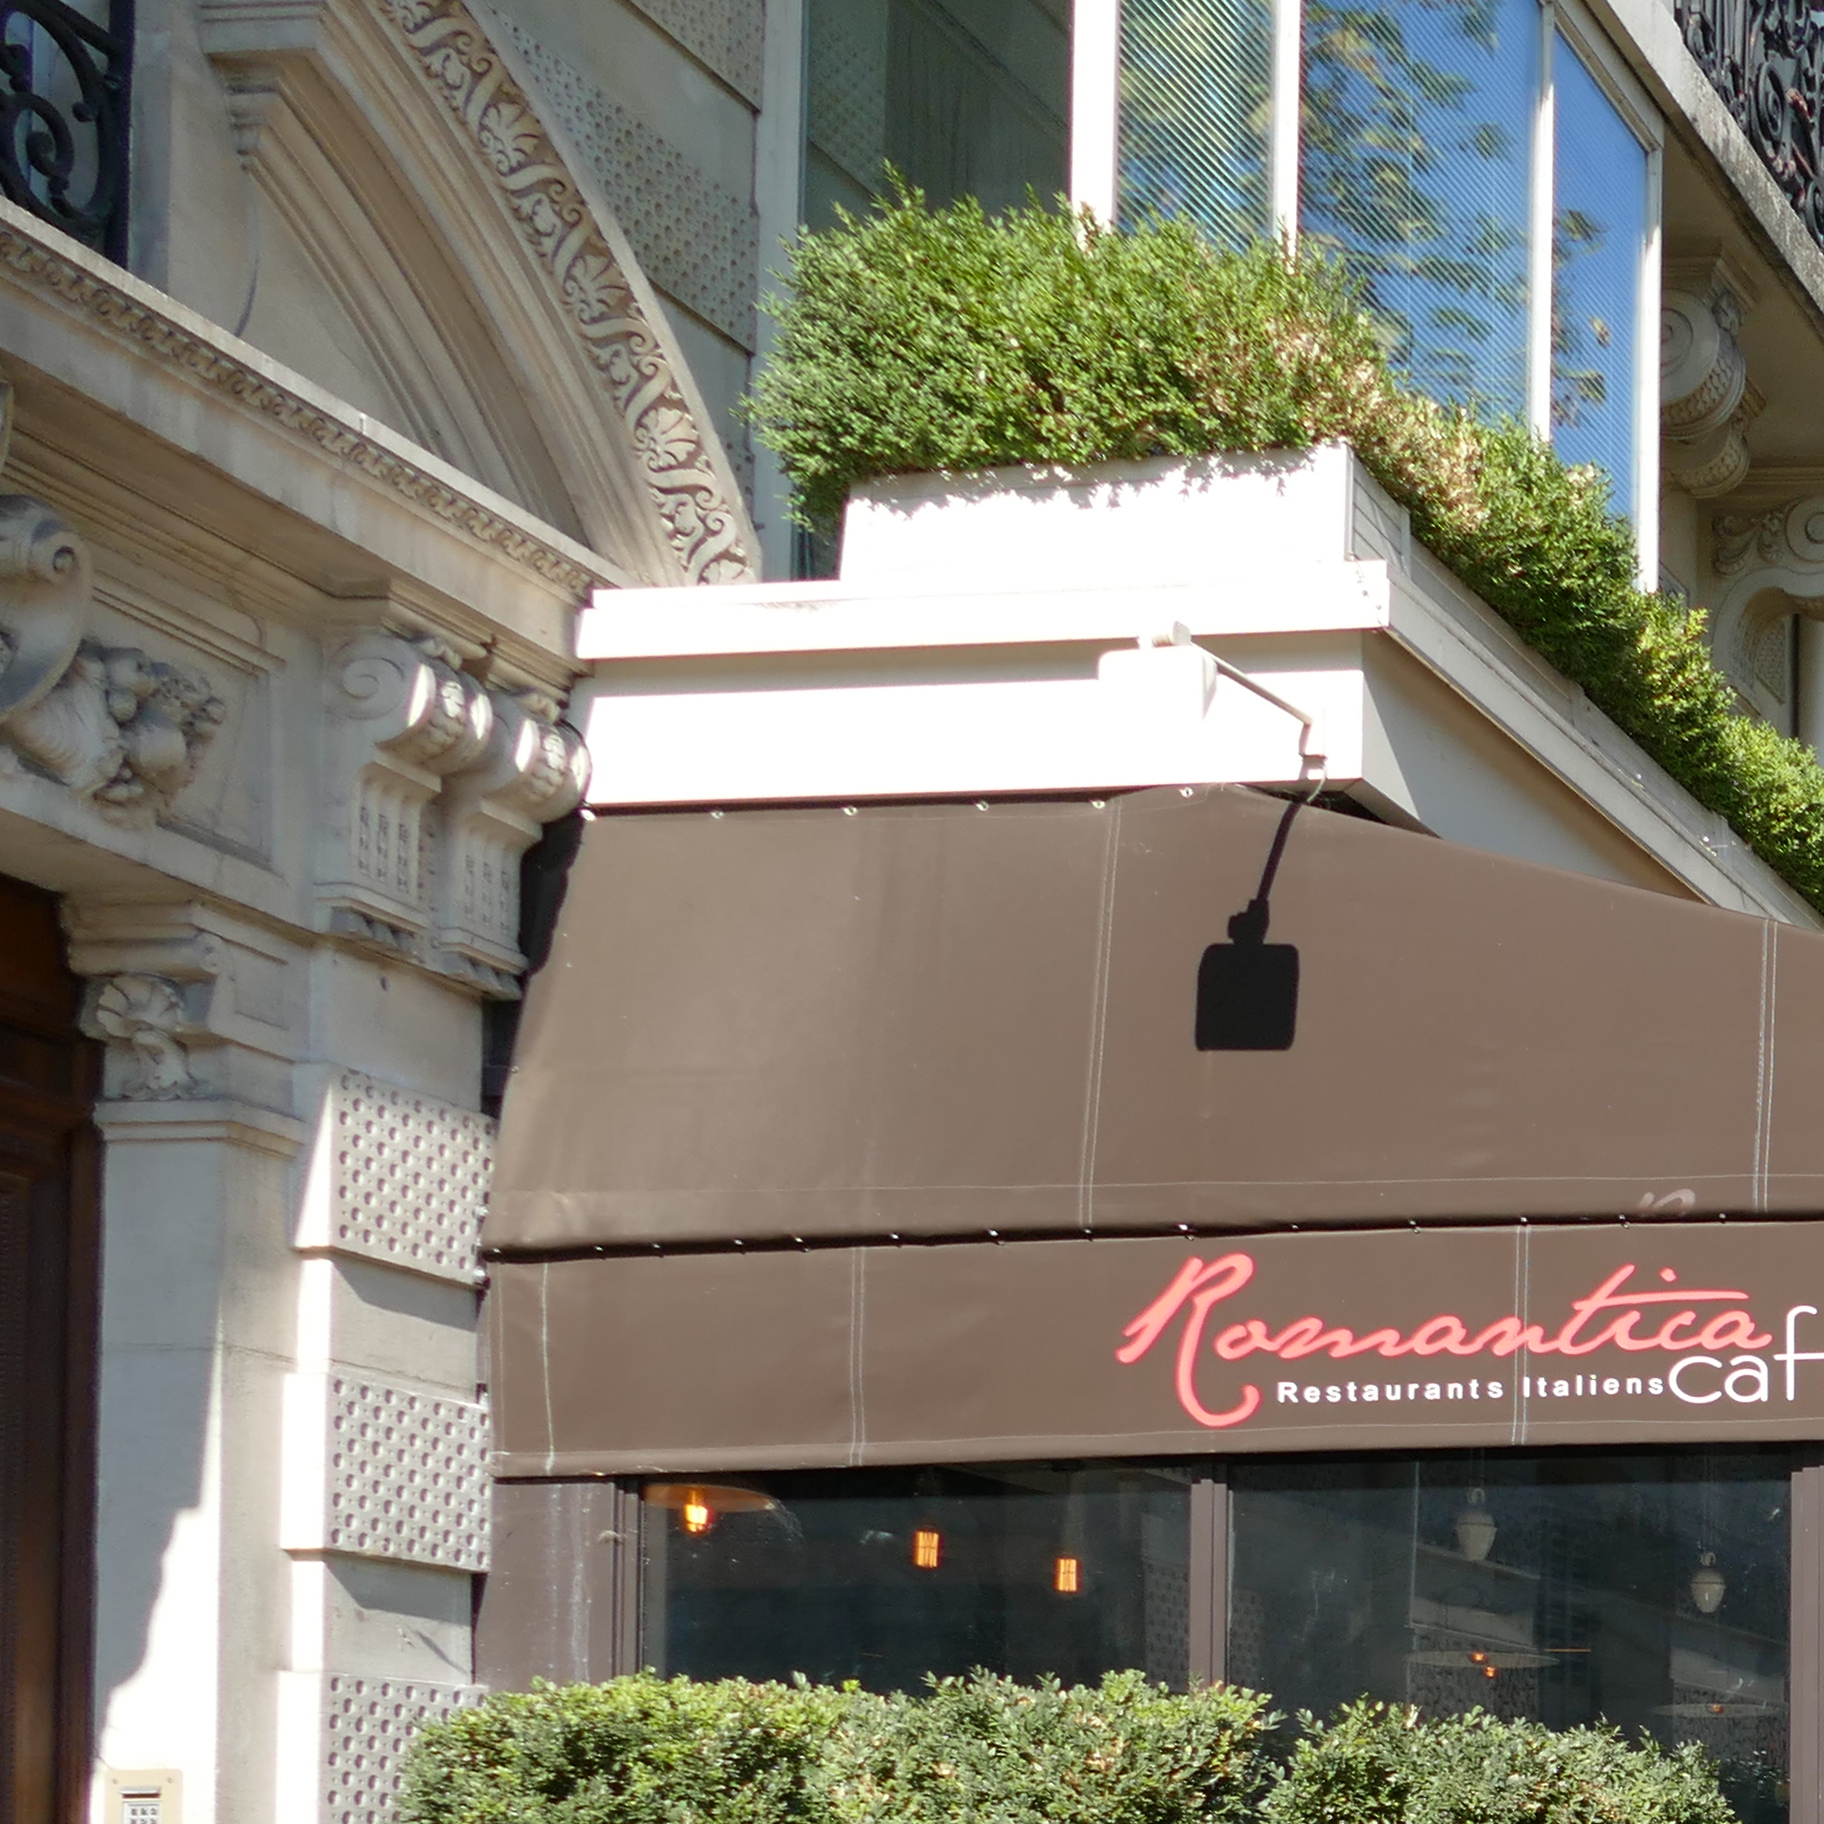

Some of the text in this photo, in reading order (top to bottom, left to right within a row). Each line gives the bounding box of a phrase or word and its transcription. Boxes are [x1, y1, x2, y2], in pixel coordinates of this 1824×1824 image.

[1116, 1252, 1771, 1428] Romantica
[1277, 1374, 1664, 1403] Restaurants Italiens
